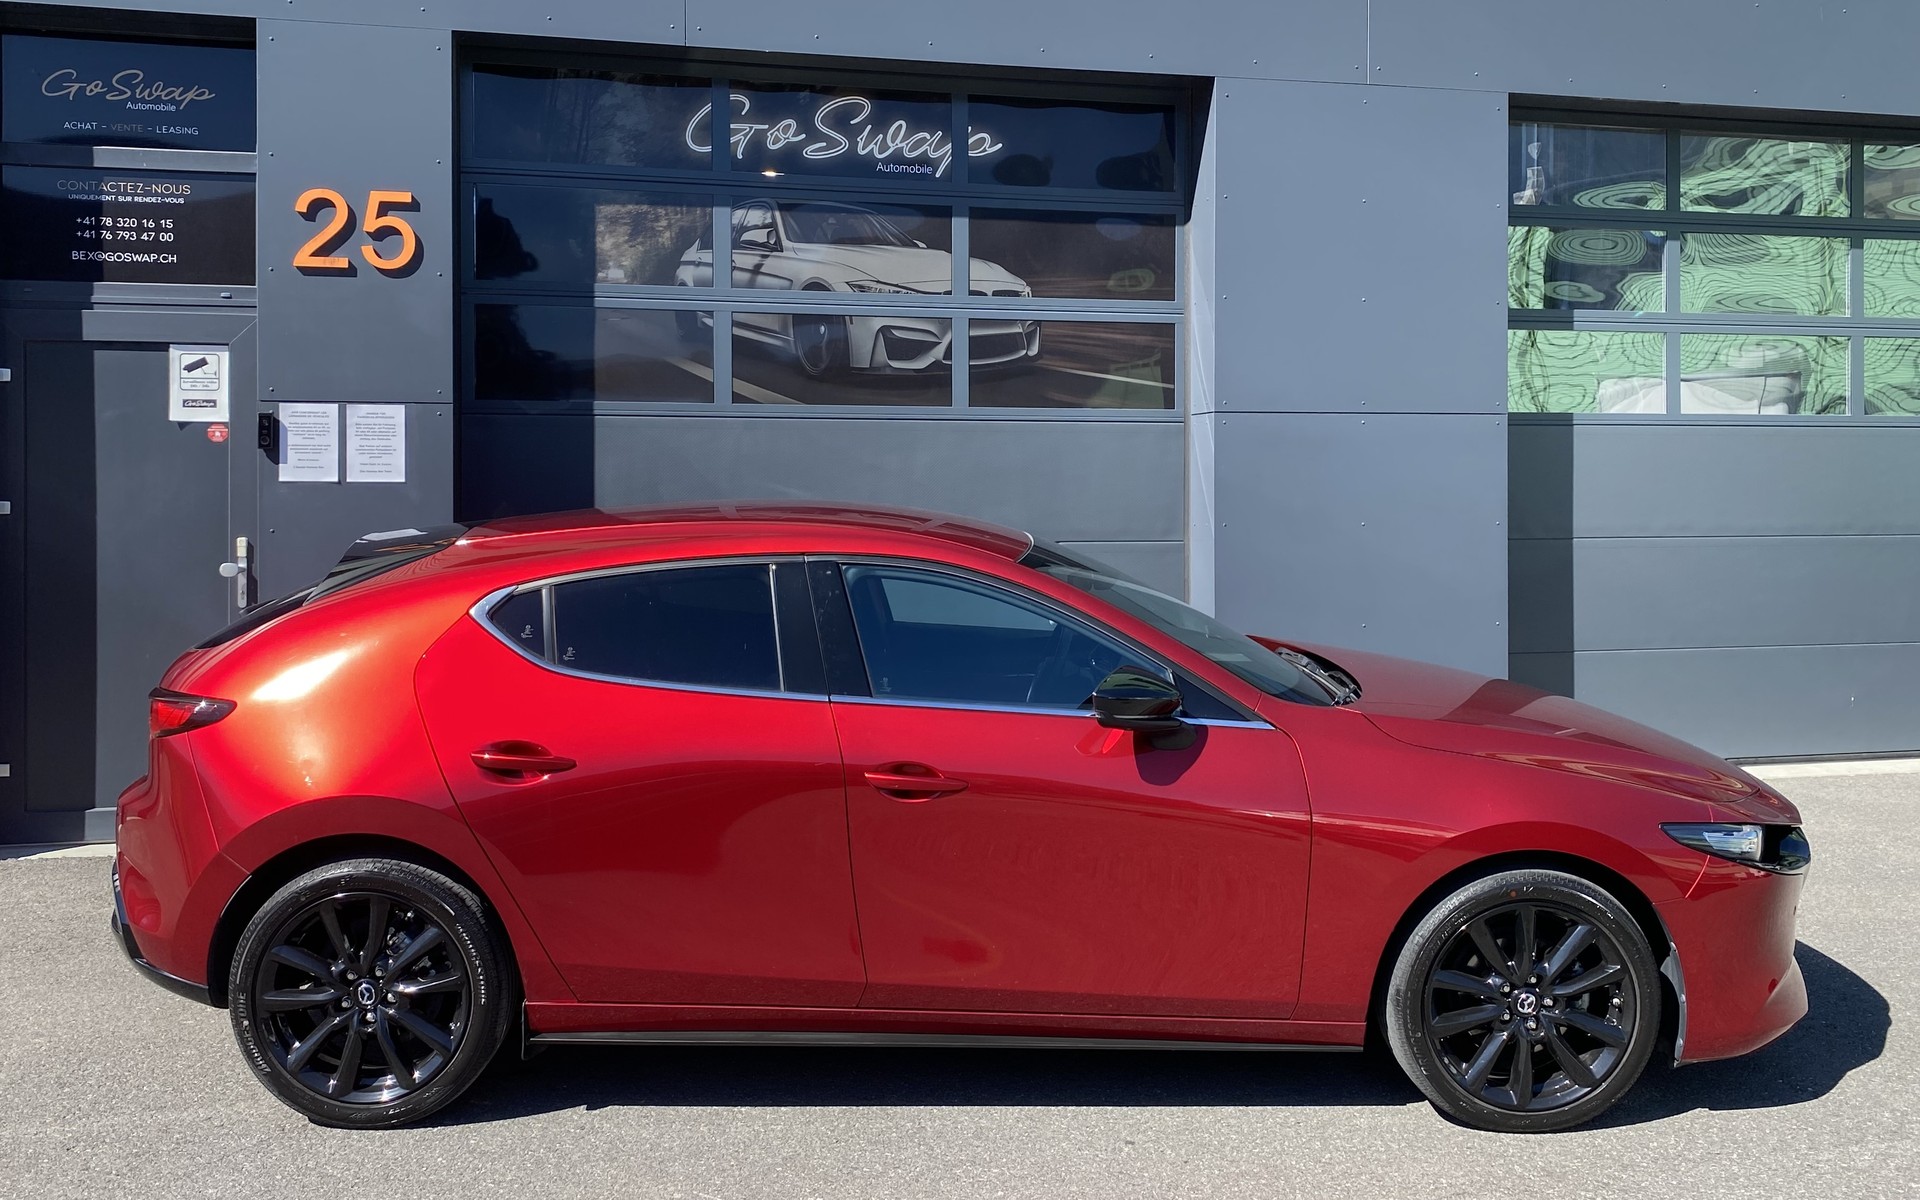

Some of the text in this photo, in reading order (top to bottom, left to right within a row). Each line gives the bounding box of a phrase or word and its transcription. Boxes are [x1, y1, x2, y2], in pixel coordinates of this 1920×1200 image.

[126, 101, 176, 112] Automobile
[63, 121, 98, 131] ACHAT
[110, 123, 144, 133] VENTE
[156, 125, 199, 135] LEASING
[876, 161, 933, 175] Automobile
[57, 180, 191, 195] CONTACTEZ-NOUS
[68, 194, 116, 202] UNIQUEMENT
[134, 196, 185, 204] RENDEZ-VOUS
[76, 216, 174, 229] +41 78 320 16 15
[292, 188, 416, 270] 25
[76, 229, 174, 242] +41 76 793 47 00
[72, 250, 177, 263] BEX@GOSWAP.CH
